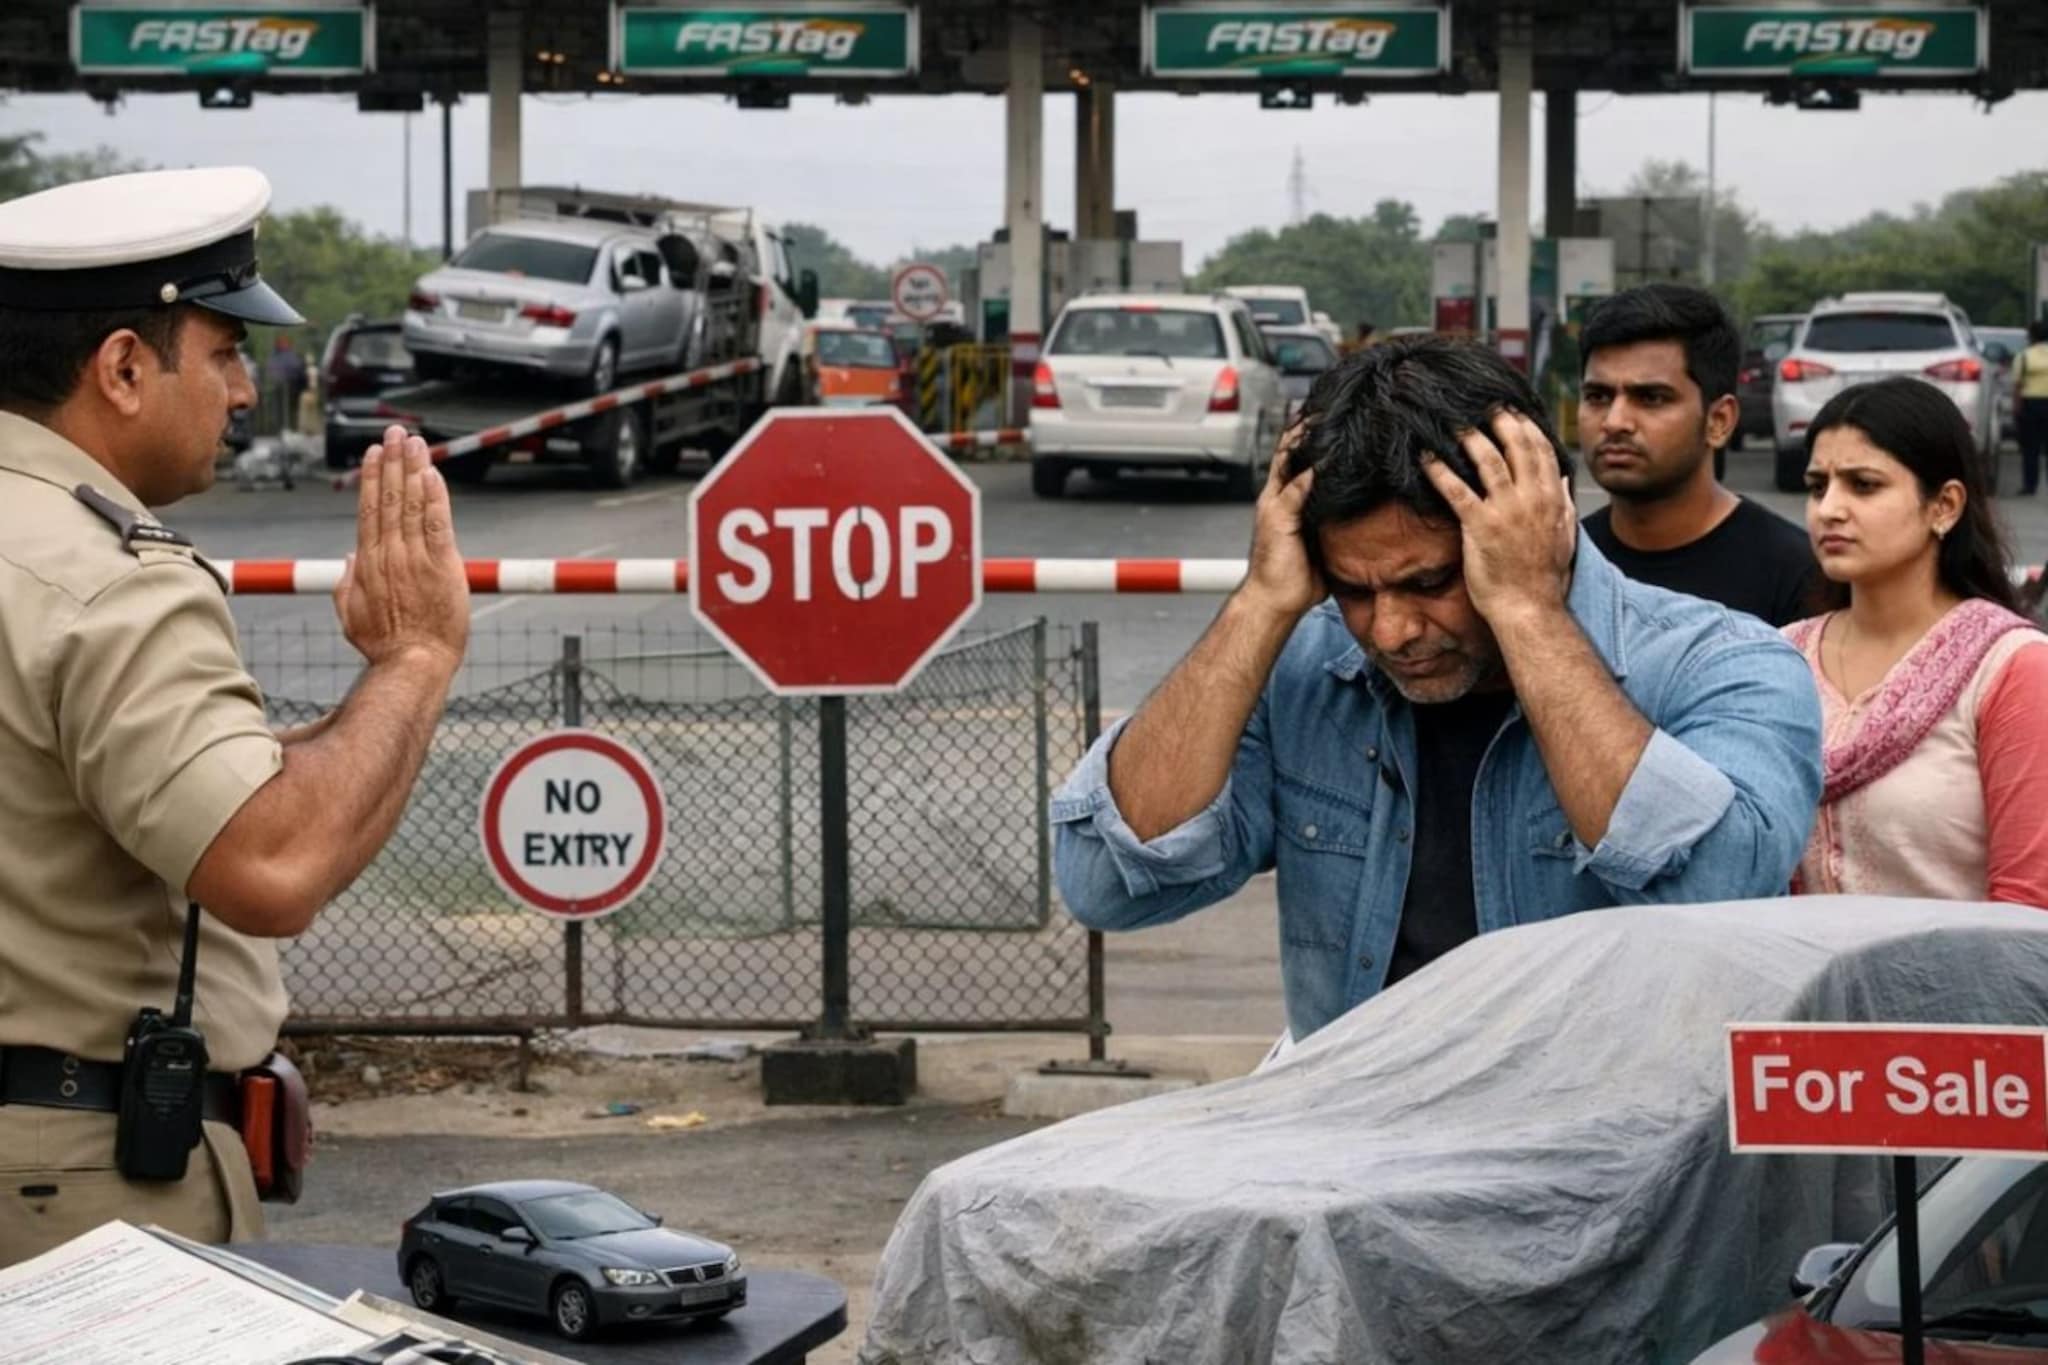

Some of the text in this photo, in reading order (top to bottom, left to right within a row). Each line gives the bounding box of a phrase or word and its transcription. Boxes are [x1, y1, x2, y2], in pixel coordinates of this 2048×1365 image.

[130, 19, 312, 59] FASTag
[676, 20, 858, 59] FASTag
[1206, 20, 1389, 59] FASTag
[1744, 19, 1928, 59] FASTag
[716, 505, 954, 604] STOP
[545, 779, 602, 814] NO
[1752, 1054, 2031, 1118] For Sale
